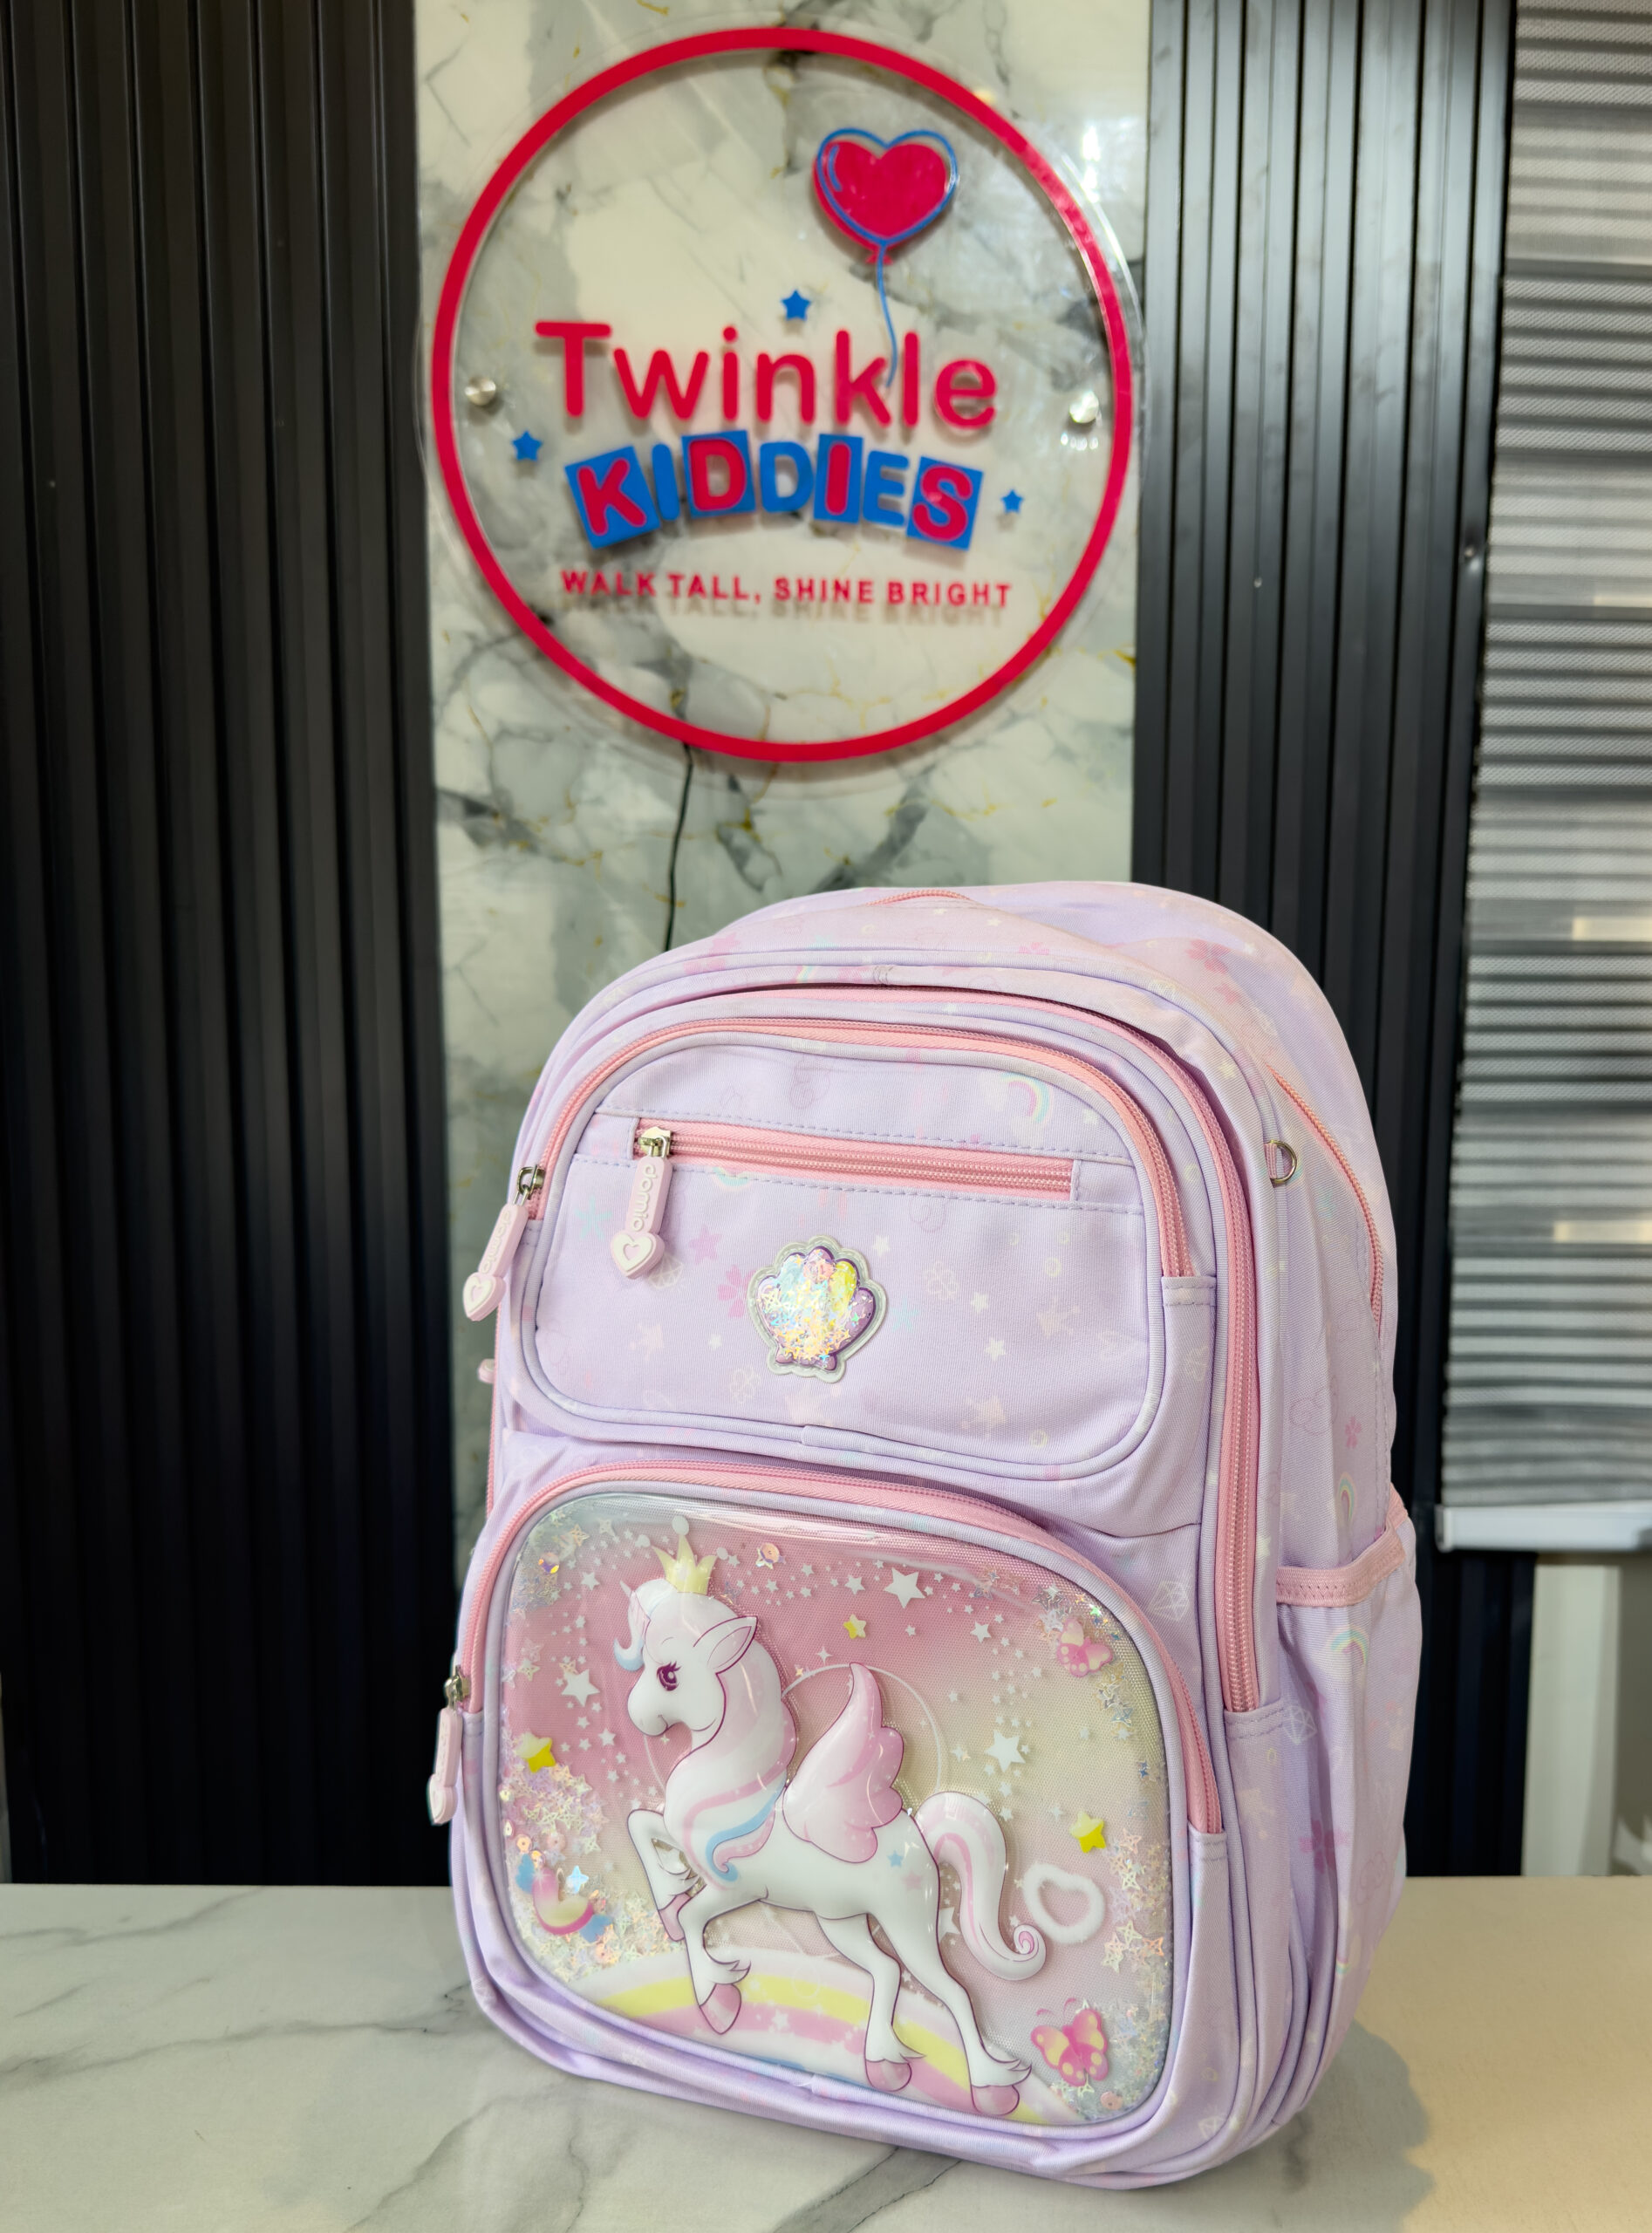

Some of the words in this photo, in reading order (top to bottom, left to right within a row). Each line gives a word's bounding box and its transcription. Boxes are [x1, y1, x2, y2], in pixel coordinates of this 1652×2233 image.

[534, 319, 998, 431] Twinkle
[565, 431, 984, 550] KIDDIES
[561, 570, 656, 598] WALK
[667, 572, 761, 604] TALL,
[774, 577, 874, 604] SHINE
[886, 580, 1012, 608] BRIGHT
